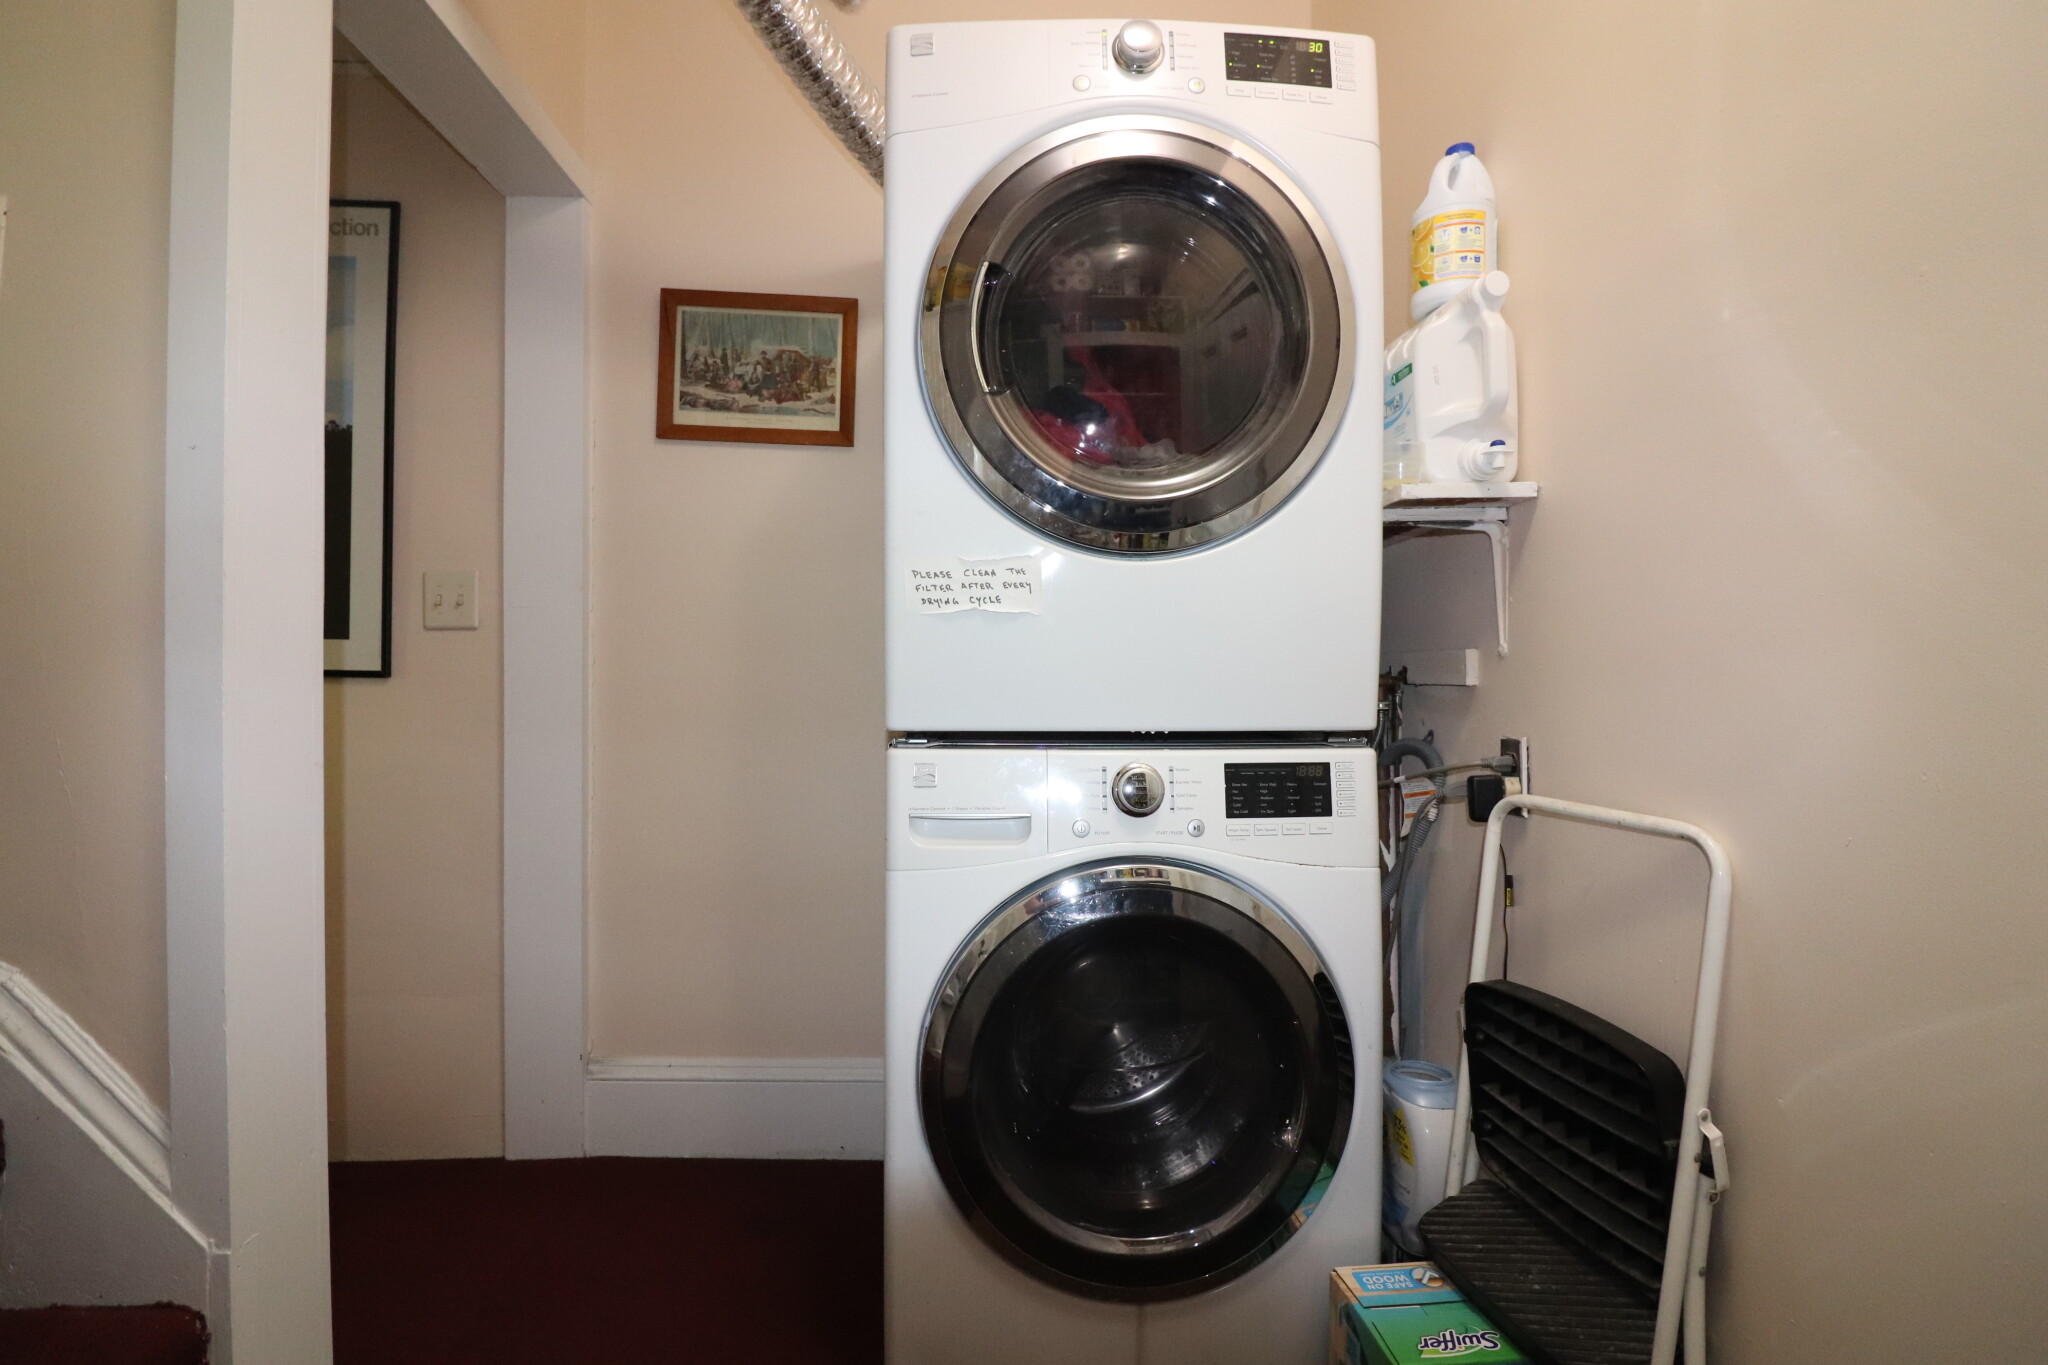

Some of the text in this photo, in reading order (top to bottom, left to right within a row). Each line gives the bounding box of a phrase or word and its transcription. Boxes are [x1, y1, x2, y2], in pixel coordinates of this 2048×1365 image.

[1309, 42, 1323, 53] 30
[330, 218, 378, 236] ction
[911, 567, 1027, 579] PLEASE CLEAN THE
[915, 581, 1032, 594] FILTER AFTER EVERY
[921, 595, 1002, 608] DRYING CYCLE
[1362, 1275, 1409, 1284] WOOD
[1386, 1281, 1413, 1289] SAFE
[1419, 1329, 1501, 1352] Swiffer
